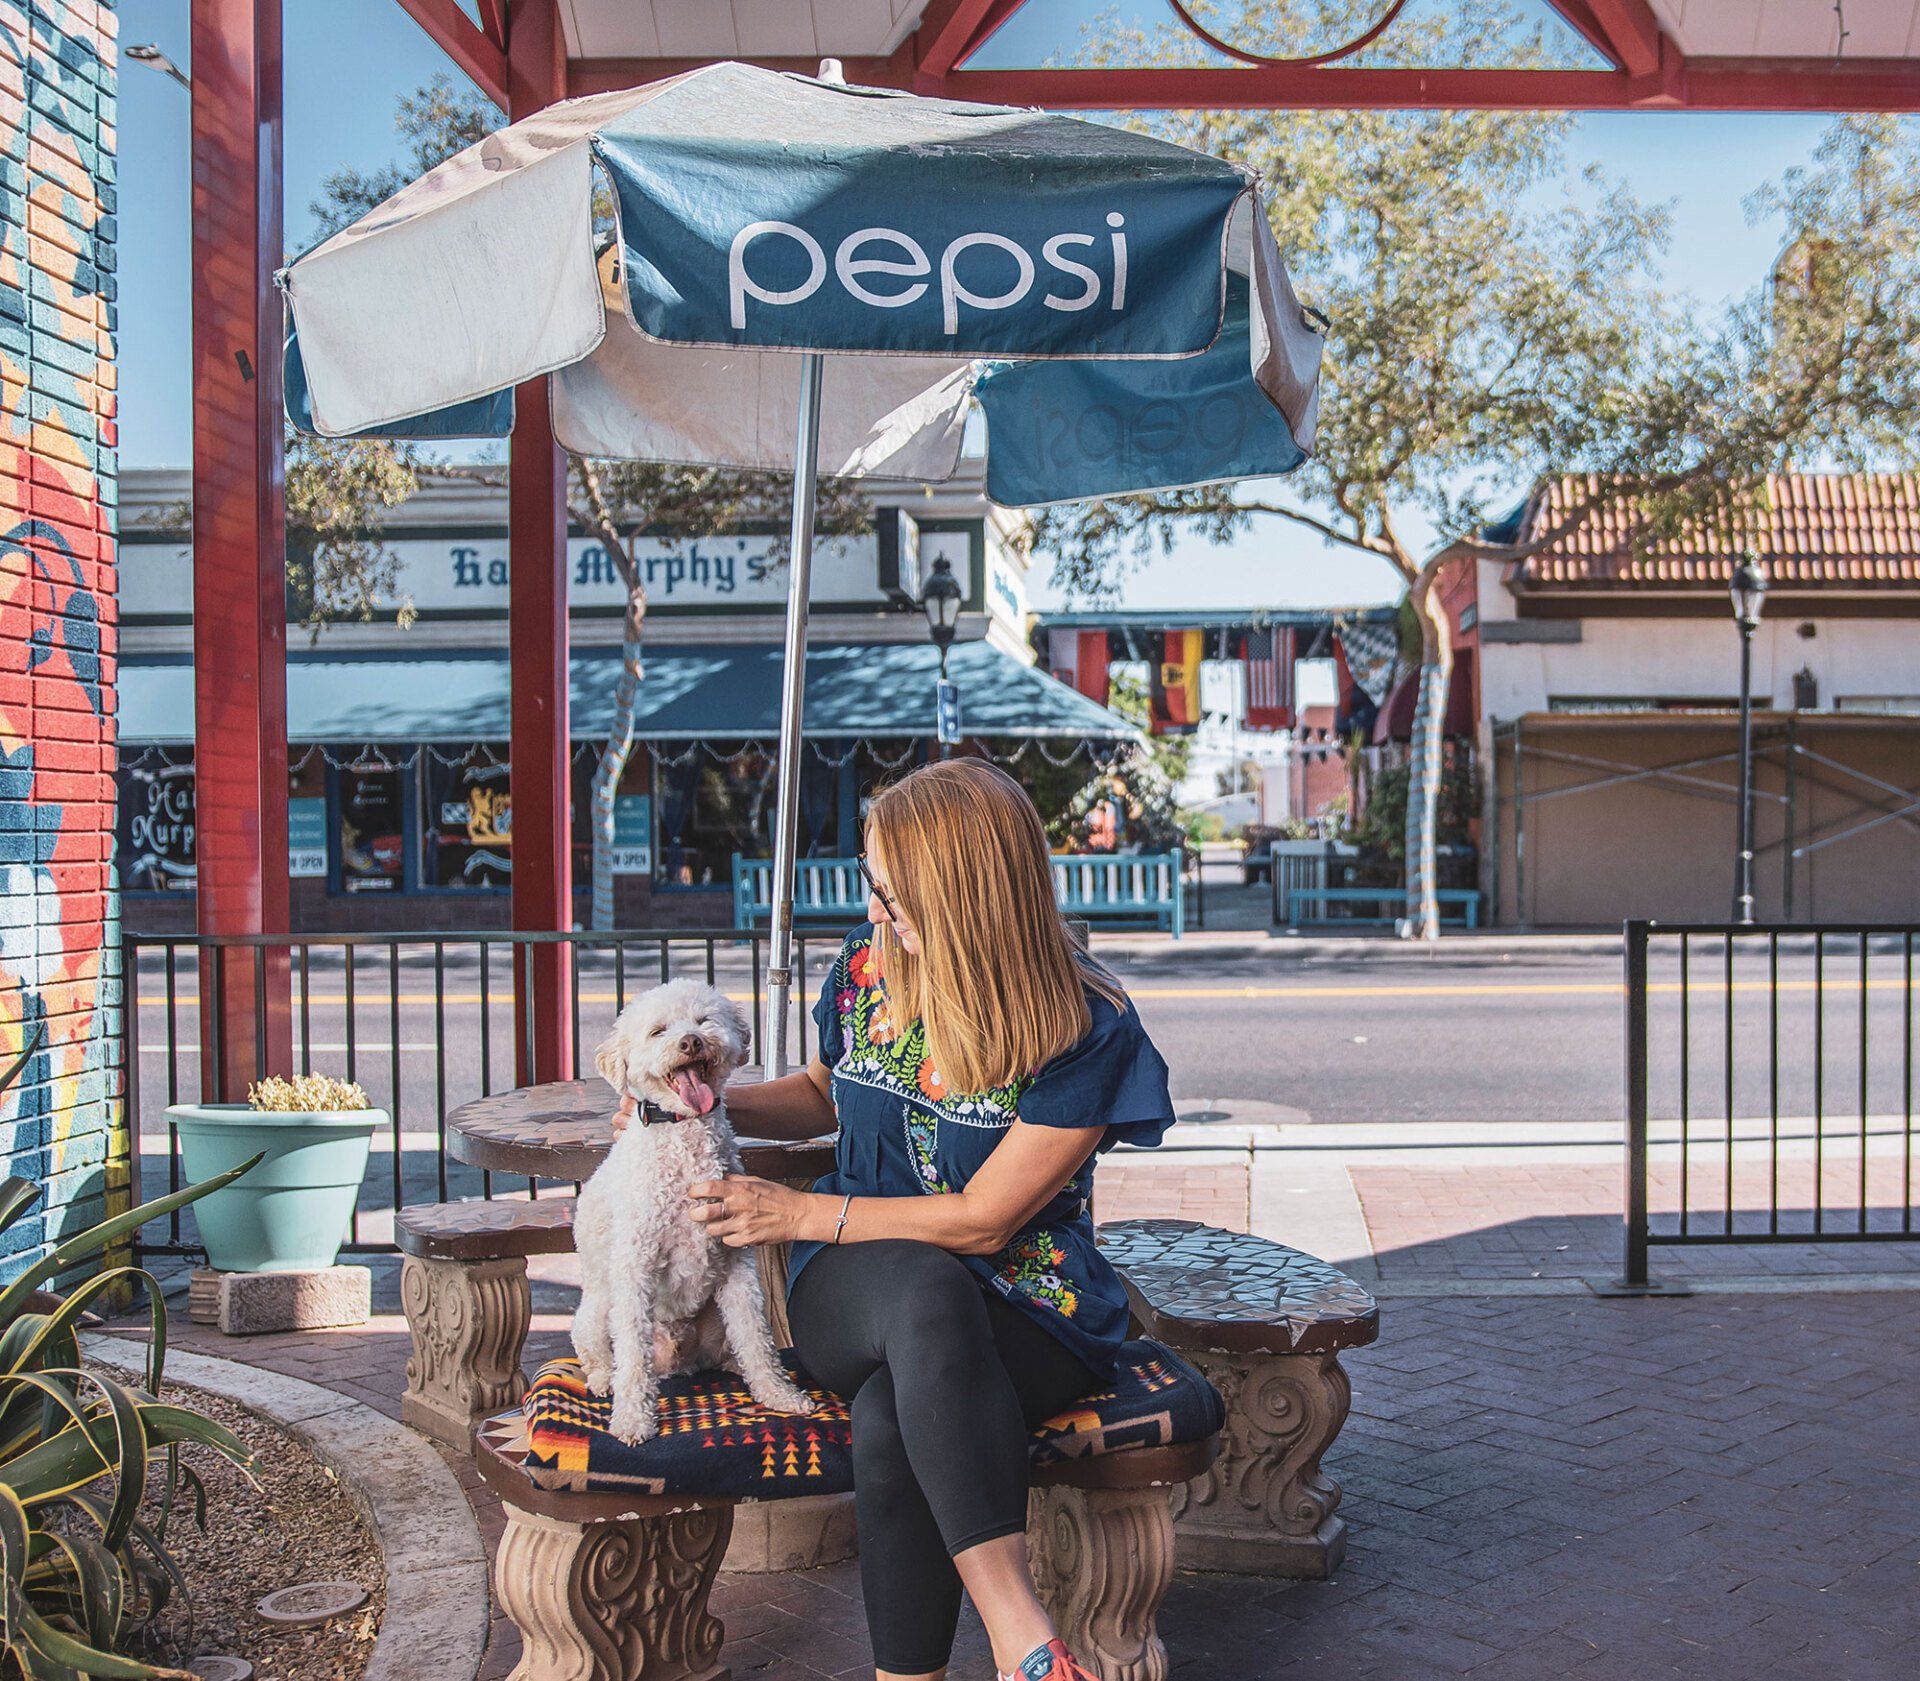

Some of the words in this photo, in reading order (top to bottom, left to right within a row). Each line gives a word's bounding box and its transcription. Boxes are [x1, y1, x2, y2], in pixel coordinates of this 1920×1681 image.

[728, 212, 1128, 335] pepsi
[451, 547, 509, 587] Ha
[148, 781, 196, 823] Ha
[131, 814, 195, 856] Murp
